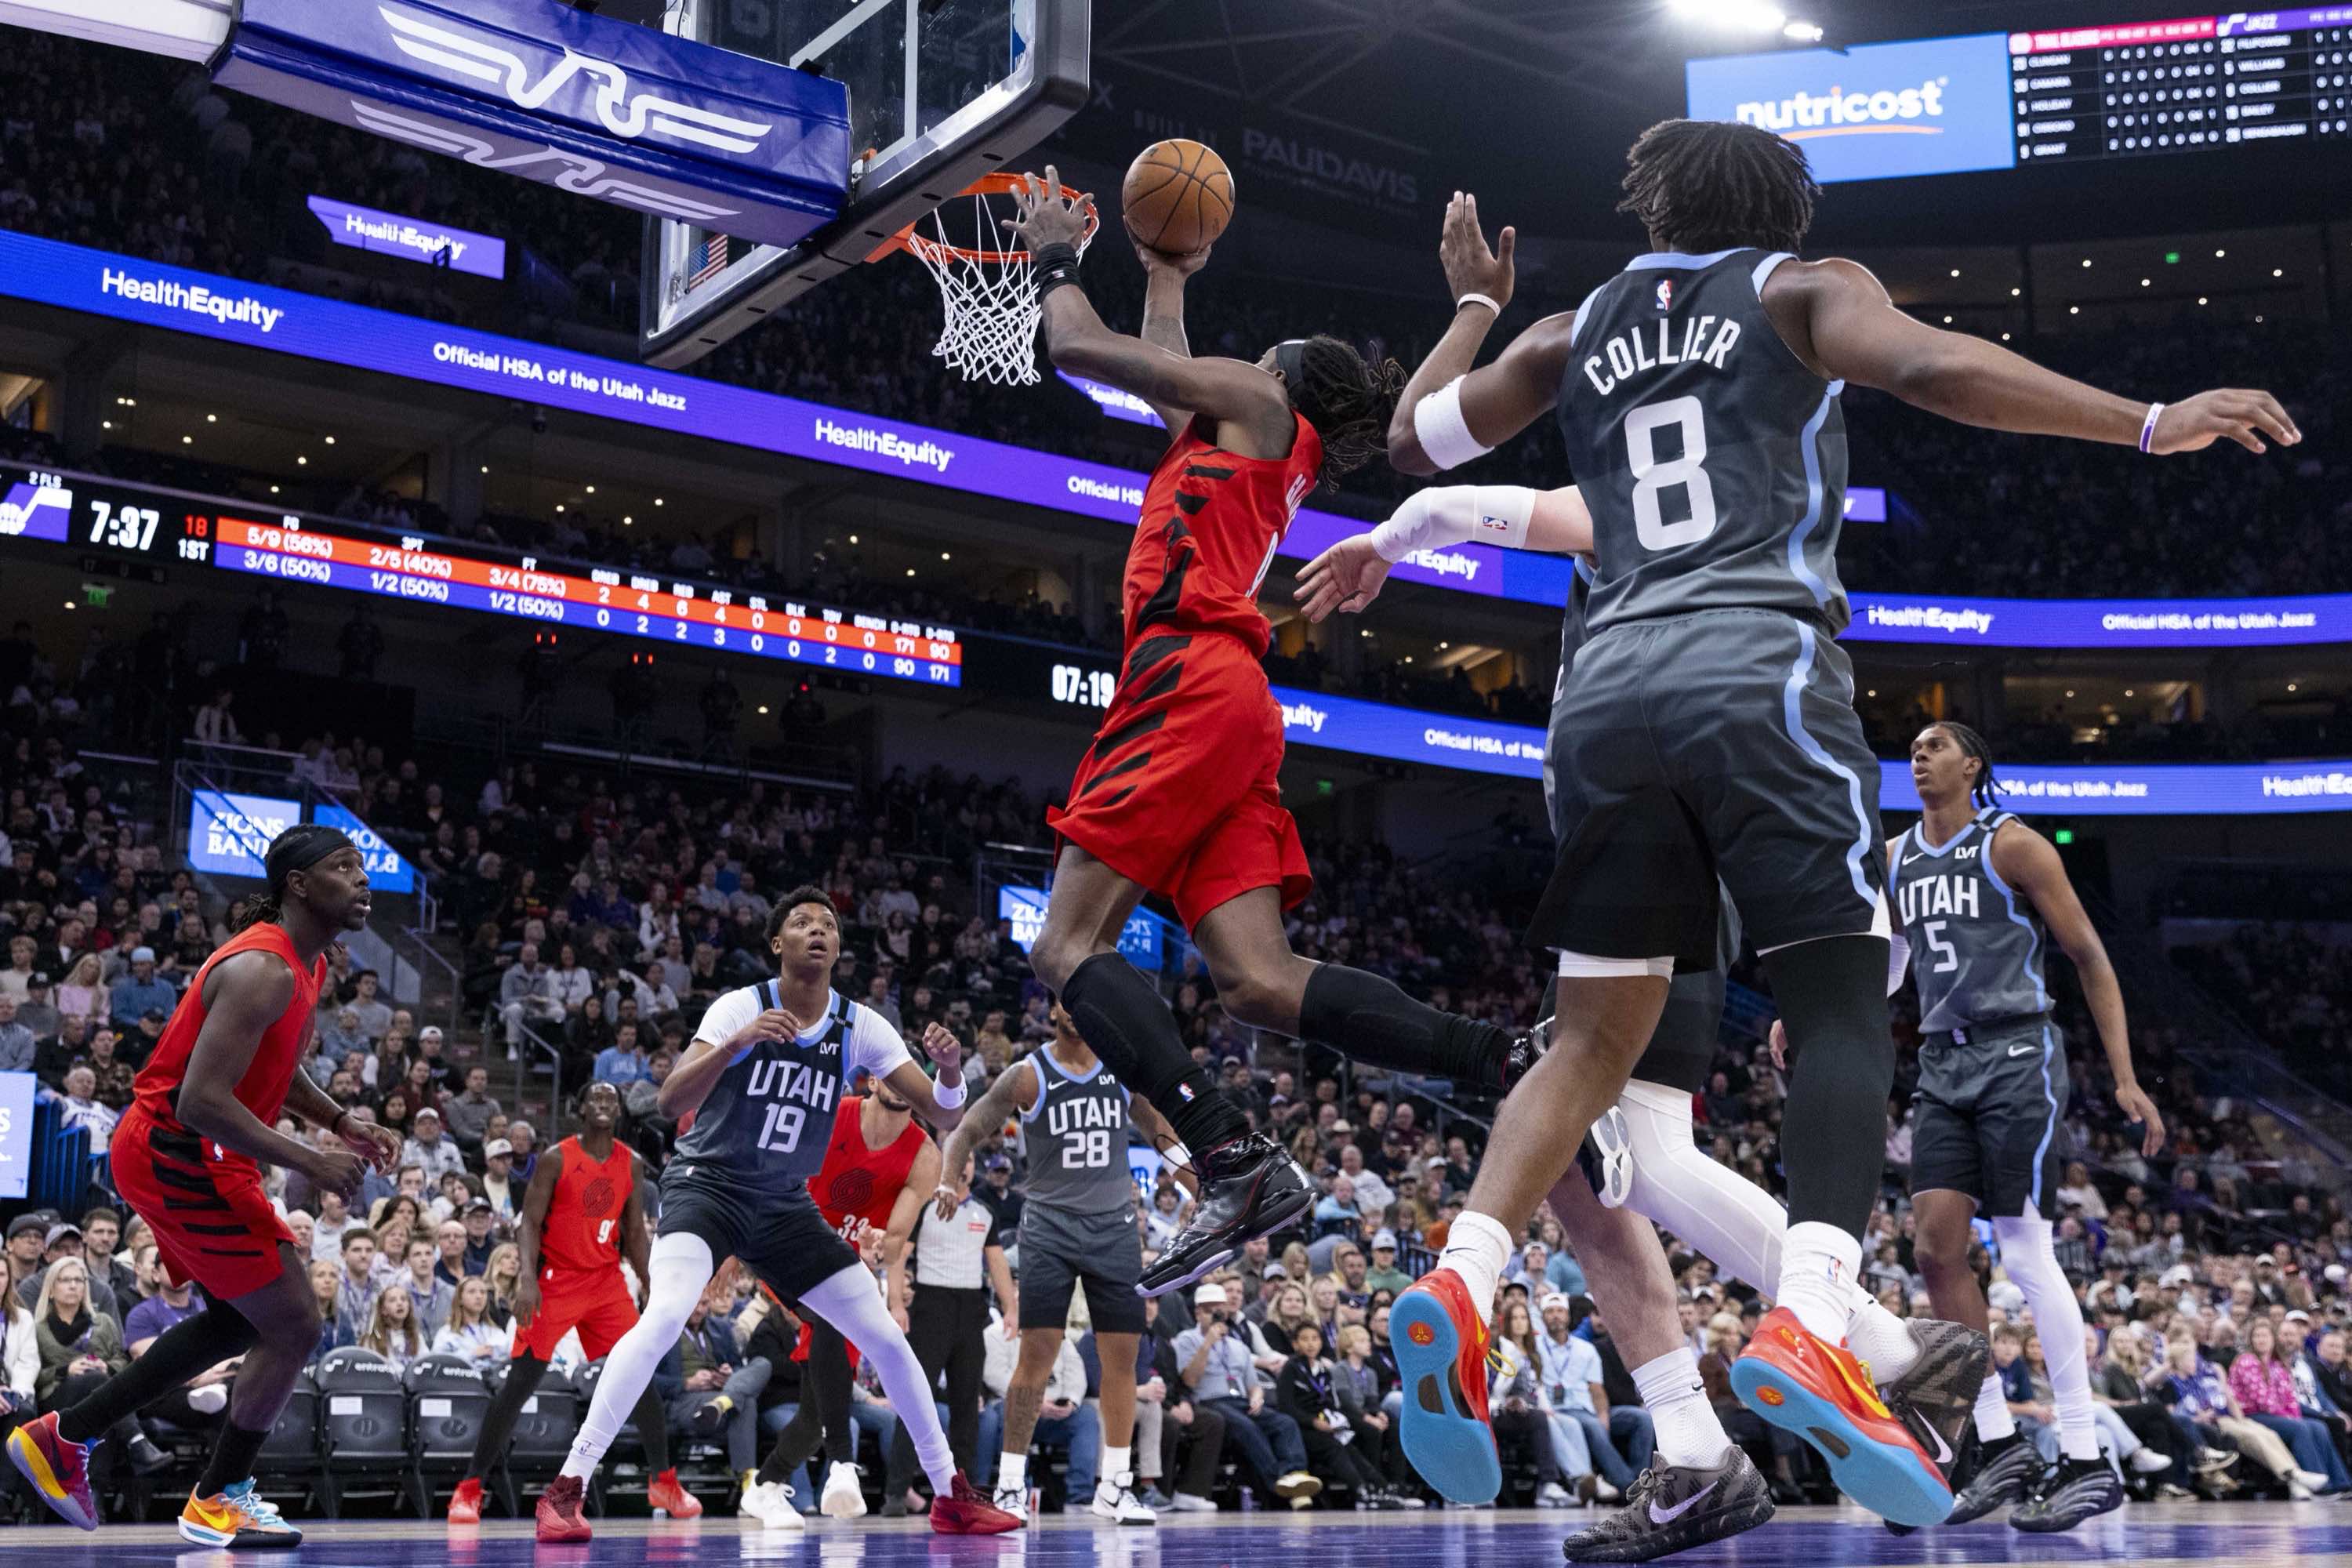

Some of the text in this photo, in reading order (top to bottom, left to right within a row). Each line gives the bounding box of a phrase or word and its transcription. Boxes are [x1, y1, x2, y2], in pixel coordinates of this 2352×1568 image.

[1736, 80, 1944, 129] nutricost
[103, 268, 281, 332] HealthEquity
[1584, 315, 1740, 395] COLLIER
[434, 343, 687, 411] Official HSA of the Utah Jazz
[815, 419, 952, 471] HealthEquity
[29, 471, 38, 485] 2
[1068, 476, 1143, 506] Official HS
[1624, 395, 1716, 550] 8
[90, 500, 159, 551] 7:37
[185, 514, 208, 537] 18
[179, 539, 210, 561] 1ST
[247, 526, 281, 549] 5/9
[369, 546, 402, 569] 2/5
[403, 553, 452, 581] (40%)
[488, 567, 521, 589] 3/4
[522, 573, 566, 600] (75%)
[599, 586, 609, 603] 2
[637, 593, 649, 609] 4
[677, 600, 688, 616] 6
[715, 607, 726, 622] 4
[752, 612, 764, 629] 0
[789, 619, 801, 635] 0
[826, 626, 837, 641] 0
[864, 632, 875, 648] 0
[895, 638, 915, 654] 171
[930, 643, 950, 660] 90
[401, 536, 424, 553] 3PT
[522, 557, 537, 572] FT
[712, 590, 731, 605] AST
[750, 597, 768, 612] STL
[786, 602, 806, 618] BLK
[244, 550, 949, 681] 3/6 (50%) 1/2 (50%) 1/2 (50%) 0 2 2 3 0 0 2 0 90 171
[1868, 606, 1991, 633] HealthEquity
[2158, 614, 2192, 630] HSA
[2194, 614, 2211, 630] of
[2212, 614, 2238, 630] the
[2239, 613, 2277, 630] Utah
[2278, 612, 2316, 627] Jazz
[1051, 664, 1114, 707] 07:19
[1425, 728, 1544, 760] Official HSA of the
[2028, 781, 2045, 797] of
[2047, 782, 2072, 797] the
[2073, 782, 2111, 797] Utah
[2111, 781, 2147, 797] Jazz
[209, 811, 285, 835] ZIONS
[1955, 846, 1979, 859] LVT
[1898, 874, 1979, 927] UTAH
[1924, 920, 1958, 973] 5
[819, 1042, 840, 1055] LVT
[746, 1059, 837, 1113] UTAH
[757, 1104, 807, 1153] 19
[1047, 1098, 1121, 1134] UTAH
[1062, 1131, 1109, 1168] 28
[837, 1214, 869, 1242] 33
